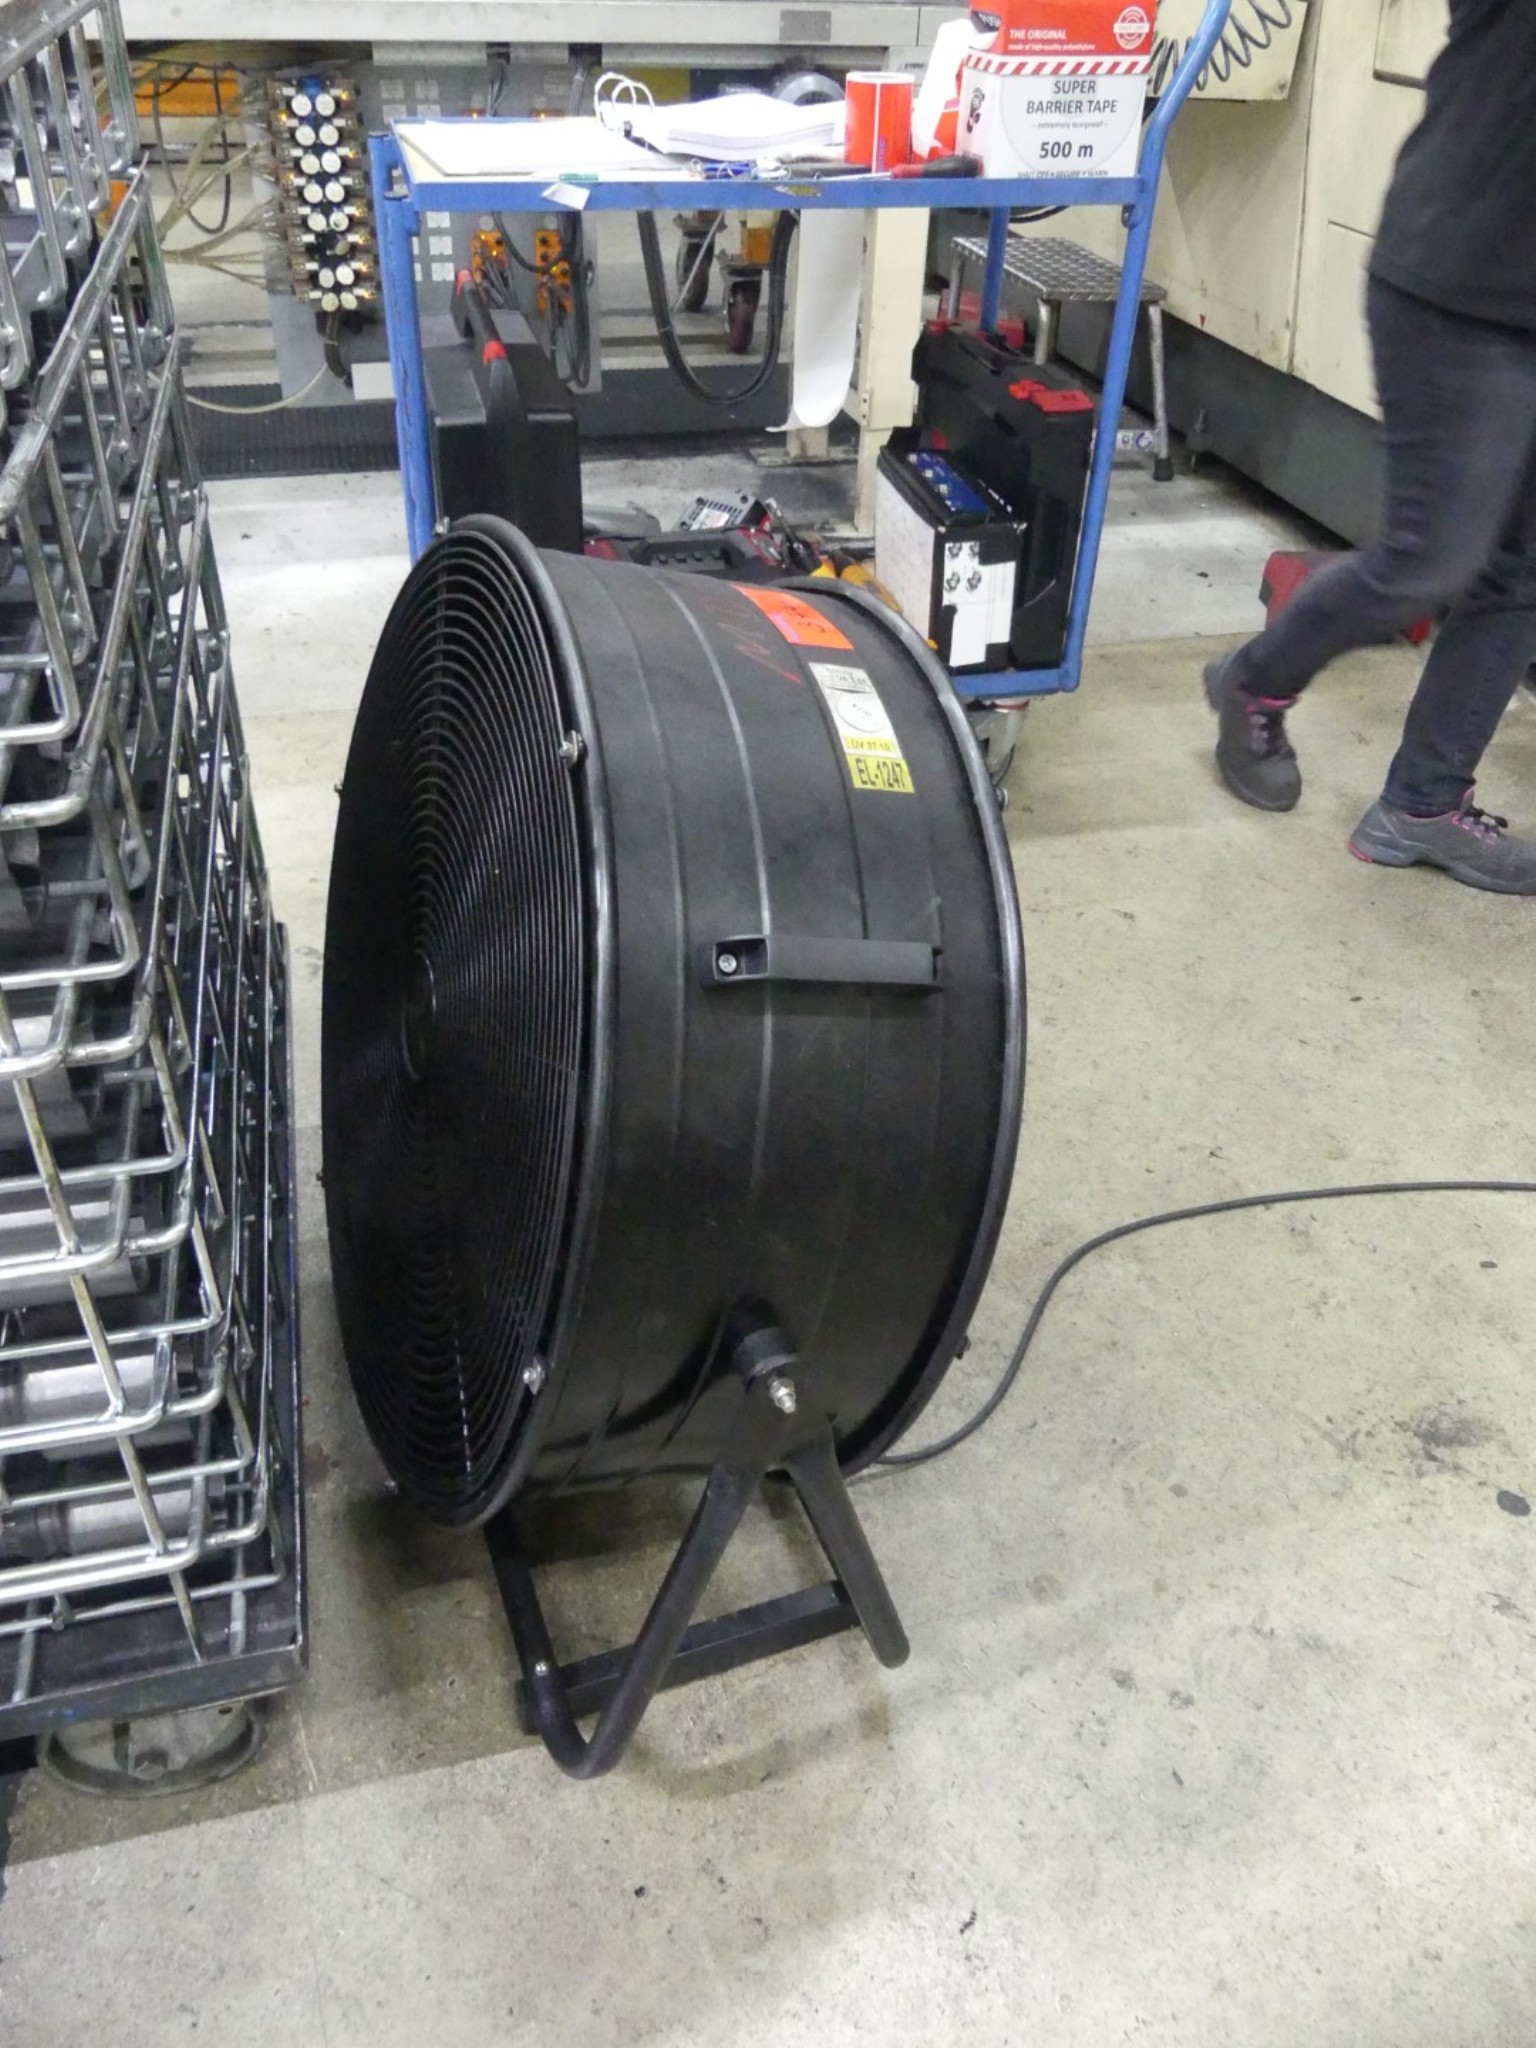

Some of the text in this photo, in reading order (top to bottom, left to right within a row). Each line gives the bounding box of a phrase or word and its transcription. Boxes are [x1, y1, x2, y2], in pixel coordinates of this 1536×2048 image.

[1009, 28, 1067, 39] THE ORIGINAL
[1053, 80, 1096, 94] SUPER
[1026, 100, 1118, 114] BARRIER TAPE
[1039, 141, 1093, 159] 500 m
